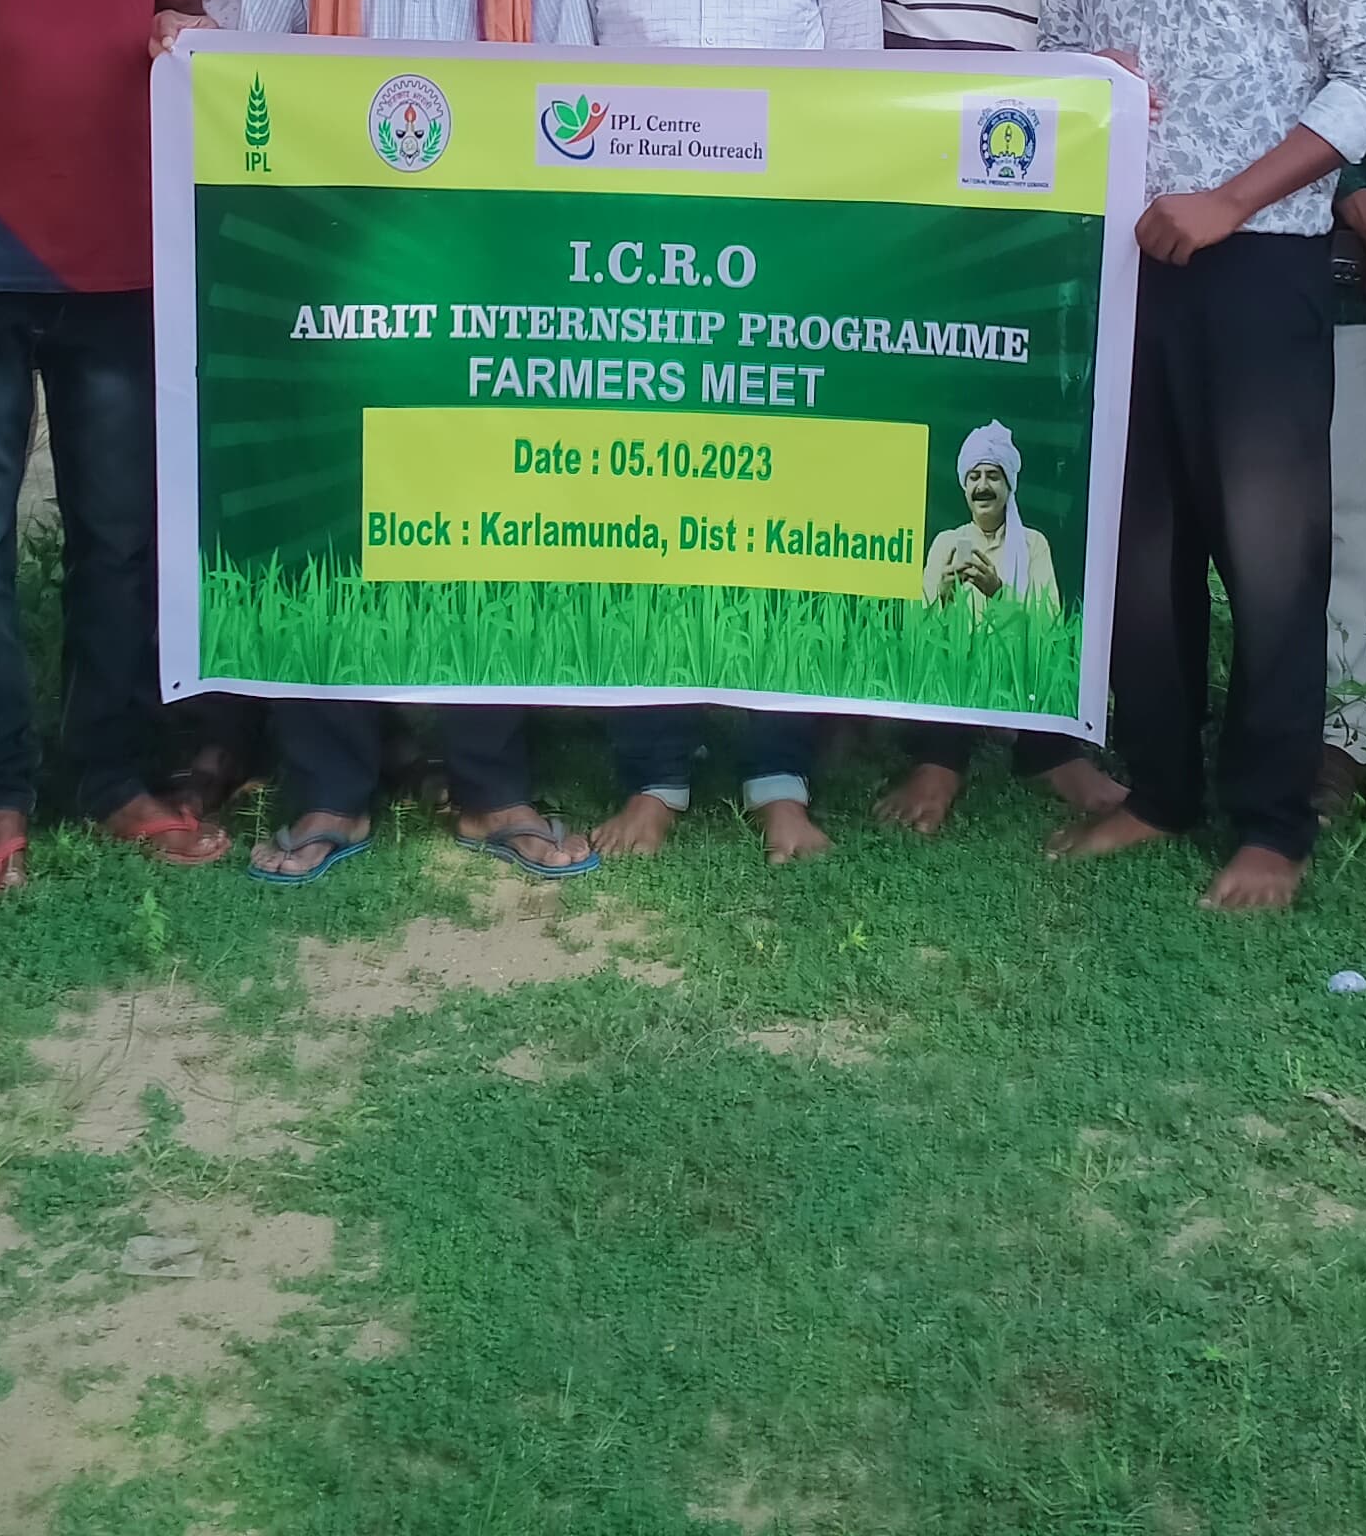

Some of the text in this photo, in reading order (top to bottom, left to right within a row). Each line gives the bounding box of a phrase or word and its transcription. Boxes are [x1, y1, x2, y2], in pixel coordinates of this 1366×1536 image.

[610, 114, 701, 133] IPL Centre
[246, 151, 272, 172] IPL
[609, 138, 763, 160] for Rural Outreach
[569, 241, 757, 288] I.C.R.O
[290, 304, 1029, 363] AMRIT INTERNSHIP PROGRAMME
[469, 357, 825, 407] FARMERS MEET
[514, 438, 582, 475] Date
[610, 439, 772, 481] 05.10.2023
[368, 512, 451, 546] Block
[481, 512, 668, 557] Karlamunda,
[680, 515, 736, 552] Dist
[765, 519, 913, 564] Kalahandi
